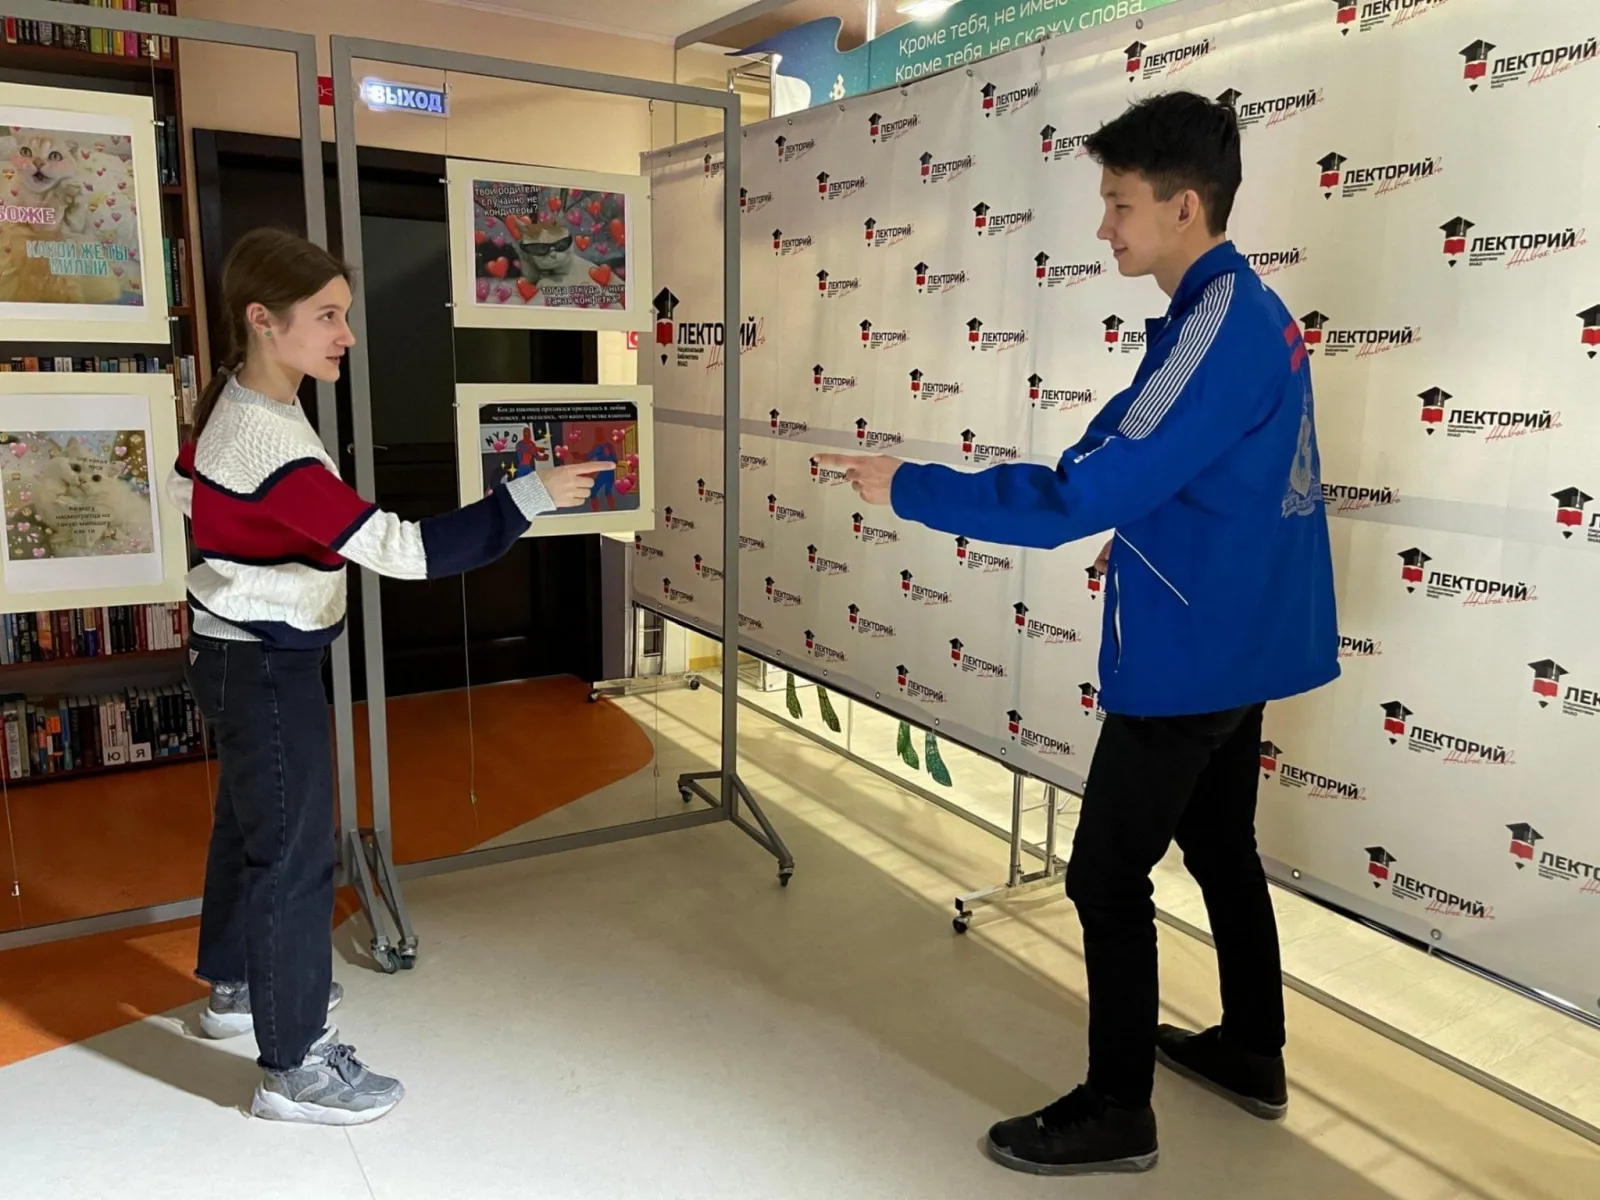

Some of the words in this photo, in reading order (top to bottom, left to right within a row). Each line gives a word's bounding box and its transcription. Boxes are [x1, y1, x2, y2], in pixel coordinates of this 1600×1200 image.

[899, 29, 946, 58] Кроме
[950, 14, 990, 40] тебя,
[995, 6, 1015, 25] не
[896, 57, 942, 82] Кроме
[990, 36, 1010, 54] не
[1144, 39, 1209, 67] ЛЕКТОРИЙ
[1493, 38, 1597, 73] ЛЕКТОРИЙ
[368, 84, 442, 112] ВЫХОД
[996, 83, 1039, 106] ЛЕКТОРИЙ
[1239, 90, 1316, 116] ЛЕКТОРИЙ
[881, 116, 917, 133] ЛЕКТОРИЙ
[1055, 134, 1090, 150] ЛЕКТО
[932, 156, 972, 175] ЛЕКТОРИЙ
[1344, 158, 1433, 184] ЛЕКТОРИЙ
[498, 186, 542, 195] родители
[829, 177, 865, 192] ЛЕКТОРИЙ
[484, 204, 538, 216] кондитеры?
[989, 208, 1032, 226] ЛЕКТОРИЙ
[875, 225, 912, 239] ЛЕКТОРИЙ
[1471, 228, 1574, 251] ЛЕКТОРИЙ
[1244, 248, 1299, 265] ТОРИЙ
[1048, 261, 1101, 278] ЛЕКТОРИЙ
[928, 271, 965, 286] ЛЕКТОРИЙ
[678, 317, 756, 345] ЛЕКТОИЙ
[871, 331, 907, 342] ЛЕКТОРИЙ
[982, 330, 1025, 343] ЛЕКТОРИЙ
[1327, 327, 1412, 343] ЛЕКТОРИЙ
[922, 382, 959, 394] ЛЕКТОРИЙ
[1042, 390, 1092, 402] ЛЕКТОРИЙ
[1449, 409, 1550, 428] ЛЕКТОРИЙ
[485, 430, 517, 446] NYPD
[866, 432, 902, 443] ЛЕКТОРИЙ
[974, 446, 1017, 457] ЛЕКТОРИЙ
[820, 470, 847, 481] ЛЕКТОРИ
[1322, 483, 1391, 503] ЕКТОРИЙ
[968, 552, 1009, 569] ЛЕКТОРИЙ
[912, 585, 948, 602] ЛЕКТОРИЙ
[1428, 572, 1527, 599] ЛЕКТОРИЙ
[1028, 620, 1076, 640] ЛЕКТОРИЙ
[963, 655, 1003, 676] ЛЕКТОРИЙ
[1022, 729, 1070, 754] ЛЕКТОРИЙ
[1410, 726, 1505, 762] ЛЕКТОРИЙ
[108, 752, 120, 760] Ю
[136, 748, 145, 758] Я
[1281, 763, 1358, 798] ЛЕКТОРИЙ
[1392, 872, 1484, 917] ЛЕКТОРИЙ
